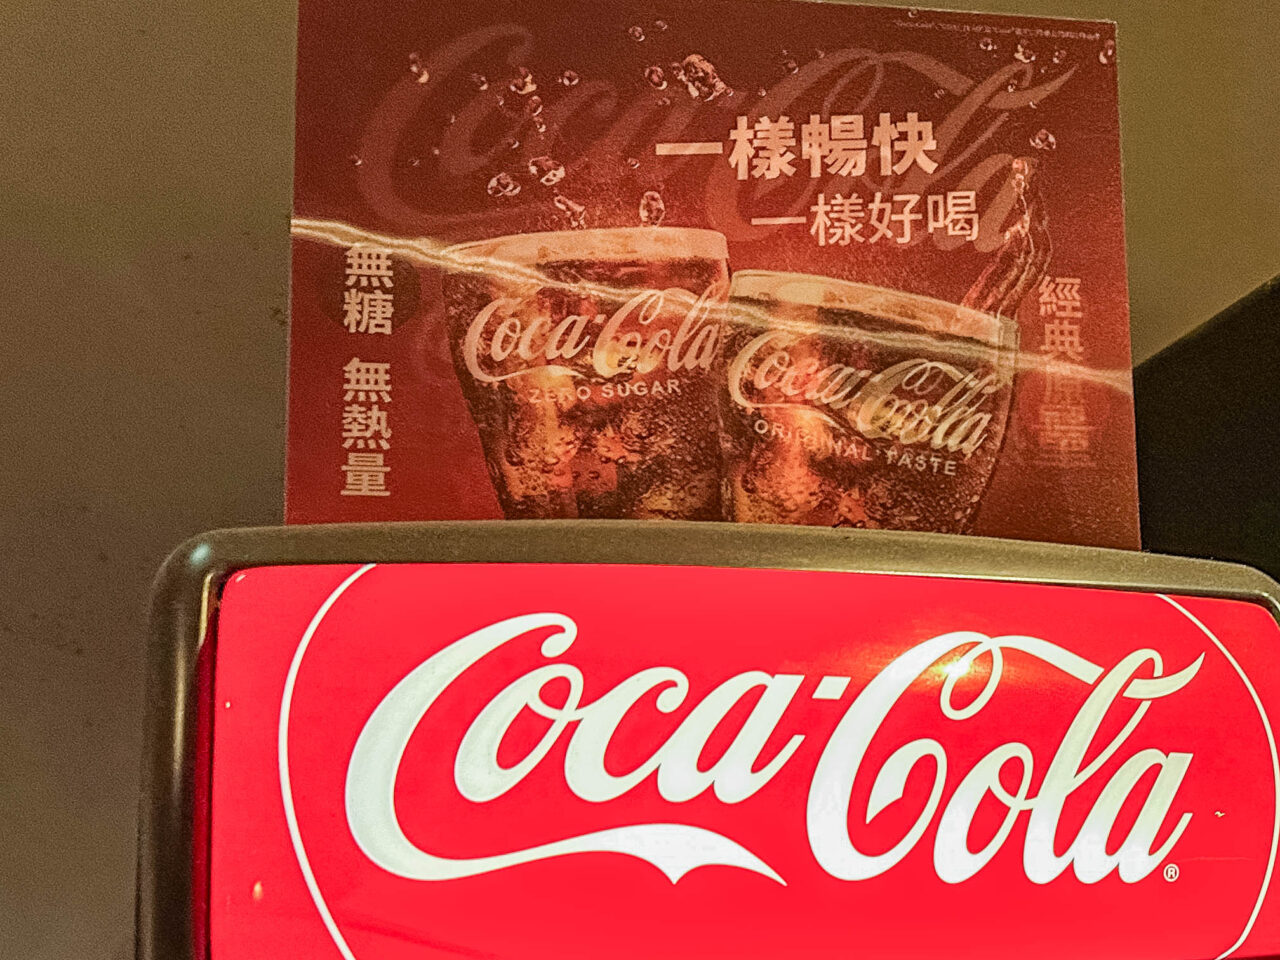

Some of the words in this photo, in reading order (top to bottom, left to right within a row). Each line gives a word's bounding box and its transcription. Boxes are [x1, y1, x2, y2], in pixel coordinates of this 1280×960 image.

[655, 112, 939, 181] 一樣暢快
[751, 190, 979, 246] 一樣好喝
[343, 246, 394, 335] 無糖
[464, 287, 728, 382] Coca-Cola
[341, 357, 392, 496] 無熱量
[601, 379, 682, 398] SUGAR
[729, 331, 998, 458] Coca-Cola
[885, 450, 957, 477] TASTE
[344, 612, 1205, 886] Coca-Cola
